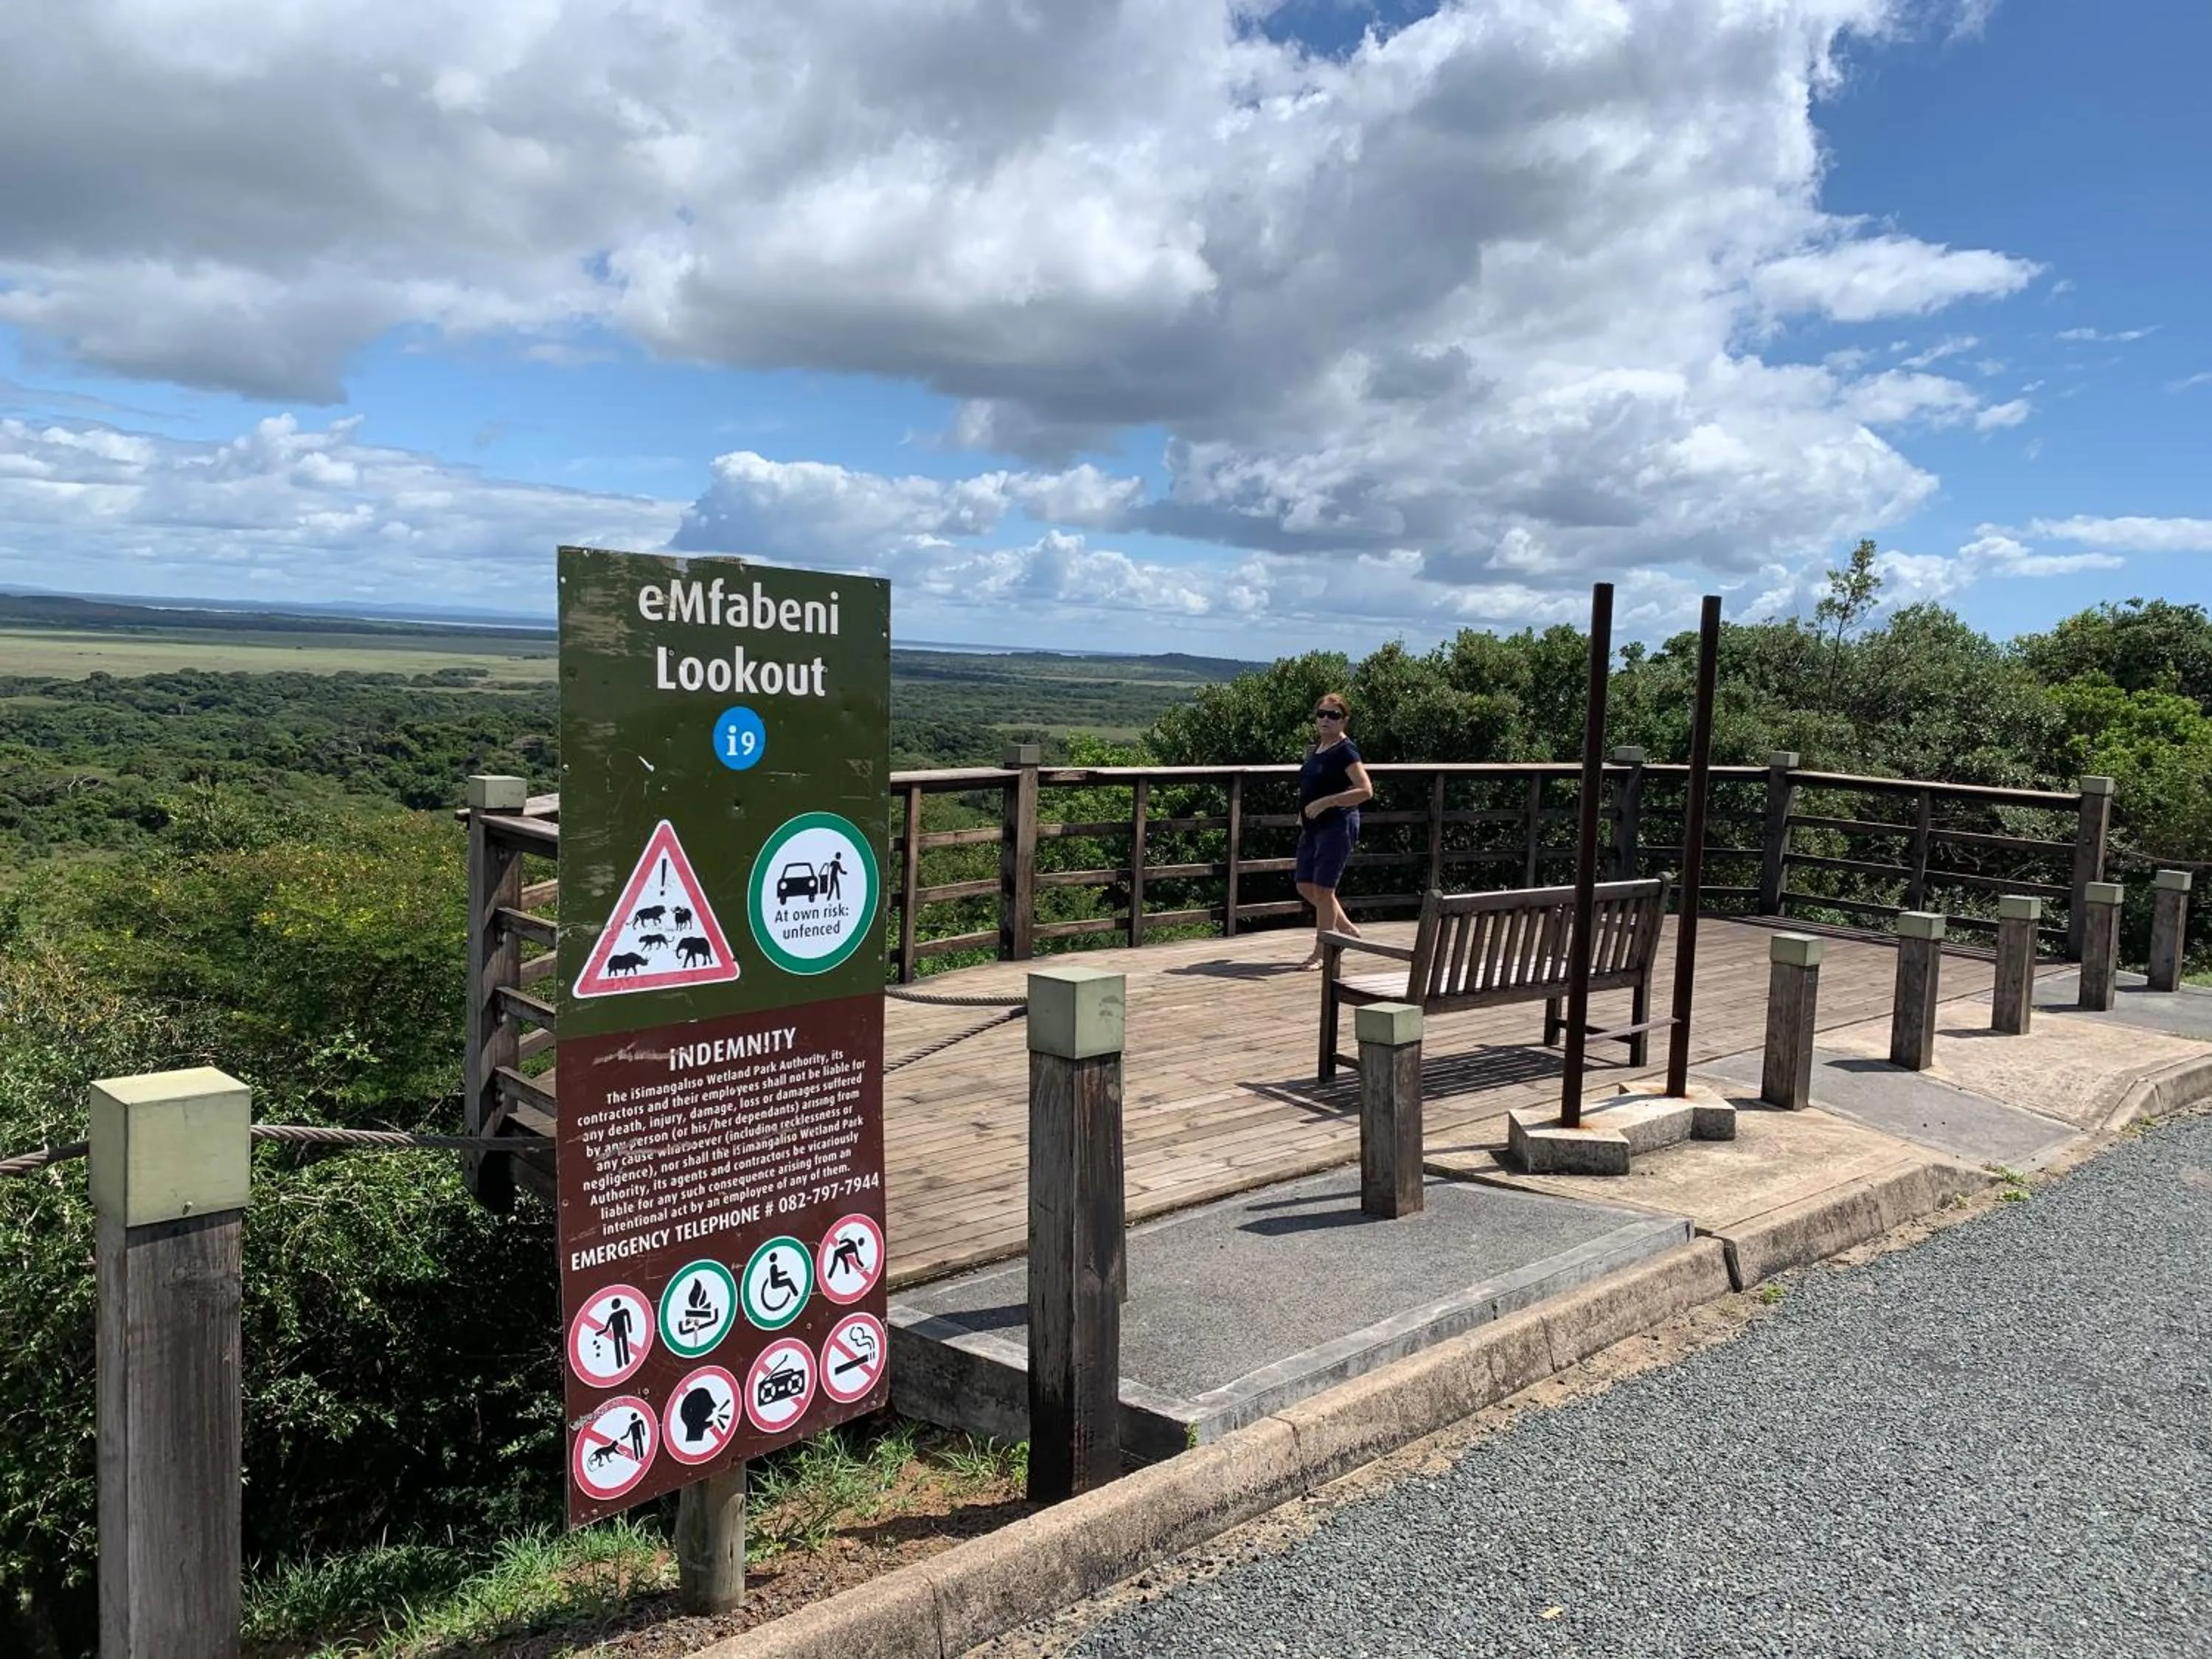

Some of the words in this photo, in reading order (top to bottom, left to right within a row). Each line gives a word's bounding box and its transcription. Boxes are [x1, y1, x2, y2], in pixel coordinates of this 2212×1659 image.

[639, 578, 838, 636] eMfabeni
[656, 646, 827, 697] Lookout
[775, 910, 789, 922] At
[793, 909, 819, 922] own
[823, 903, 849, 919] risk:
[782, 920, 841, 939] unfenced
[606, 1092, 627, 1104] The
[630, 1078, 703, 1099] iSimangaliso
[706, 1066, 751, 1084] Wetland
[754, 1062, 776, 1075] Park
[779, 1054, 829, 1070] Authority,
[832, 1050, 844, 1060] its
[669, 1026, 796, 1071] INDEMNITY
[577, 1105, 644, 1125] contractors
[647, 1098, 669, 1111] and
[671, 1093, 698, 1107] their
[701, 1082, 759, 1101] employees
[762, 1074, 786, 1088] shall
[788, 1072, 806, 1083] not
[808, 1069, 820, 1079] be
[822, 1063, 849, 1077] liable
[851, 1060, 866, 1071] for
[582, 1130, 604, 1141] any
[608, 1120, 644, 1136] death,
[649, 1114, 686, 1129] injury,
[689, 1104, 736, 1119] damage,
[739, 1098, 759, 1109] loss
[762, 1096, 773, 1105] or
[776, 1085, 820, 1102] damages
[822, 1074, 862, 1092] suffered
[585, 1146, 600, 1158] by
[603, 1141, 626, 1152] any
[628, 1132, 668, 1150] person
[672, 1127, 688, 1141] (or
[691, 1118, 731, 1133] his/her
[734, 1101, 799, 1124] dependants)
[801, 1096, 835, 1110] arising
[837, 1091, 860, 1102] from
[582, 1164, 658, 1190] negligence),
[661, 1161, 679, 1172] nor
[682, 1152, 709, 1166] shall
[712, 1148, 729, 1160] the
[732, 1134, 797, 1155] iSimangaliso
[799, 1121, 839, 1139] Wetland
[842, 1116, 863, 1130] Park
[590, 1186, 649, 1206] Authority,
[653, 1180, 667, 1191] its
[669, 1172, 707, 1189] agents
[710, 1164, 731, 1177] and
[733, 1152, 790, 1172] contractors
[793, 1147, 804, 1158] be
[807, 1134, 858, 1154] vicariously
[596, 1160, 618, 1172] any
[622, 1152, 654, 1166] cause
[658, 1136, 721, 1157] whatsoever
[725, 1124, 777, 1146] (including
[780, 1110, 838, 1130] recklessness
[840, 1107, 852, 1116] or
[600, 1204, 634, 1220] liable
[637, 1200, 653, 1210] for
[656, 1194, 677, 1206] any
[680, 1184, 706, 1200] such
[708, 1169, 775, 1192] consequence
[778, 1160, 811, 1175] arising
[813, 1154, 837, 1166] from
[839, 1150, 851, 1160] an
[602, 1210, 667, 1236] intentional
[671, 1206, 687, 1218] act
[690, 1202, 703, 1214] by
[706, 1199, 720, 1208] an
[723, 1185, 774, 1204] employee
[777, 1178, 787, 1190] of
[790, 1176, 807, 1187] any
[810, 1170, 820, 1182] of
[822, 1166, 850, 1178] them.
[571, 1228, 669, 1270] EMERGENCY
[675, 1203, 759, 1242] TELEPHONE
[764, 1200, 773, 1217] #
[779, 1171, 879, 1213] 082-797-7944
